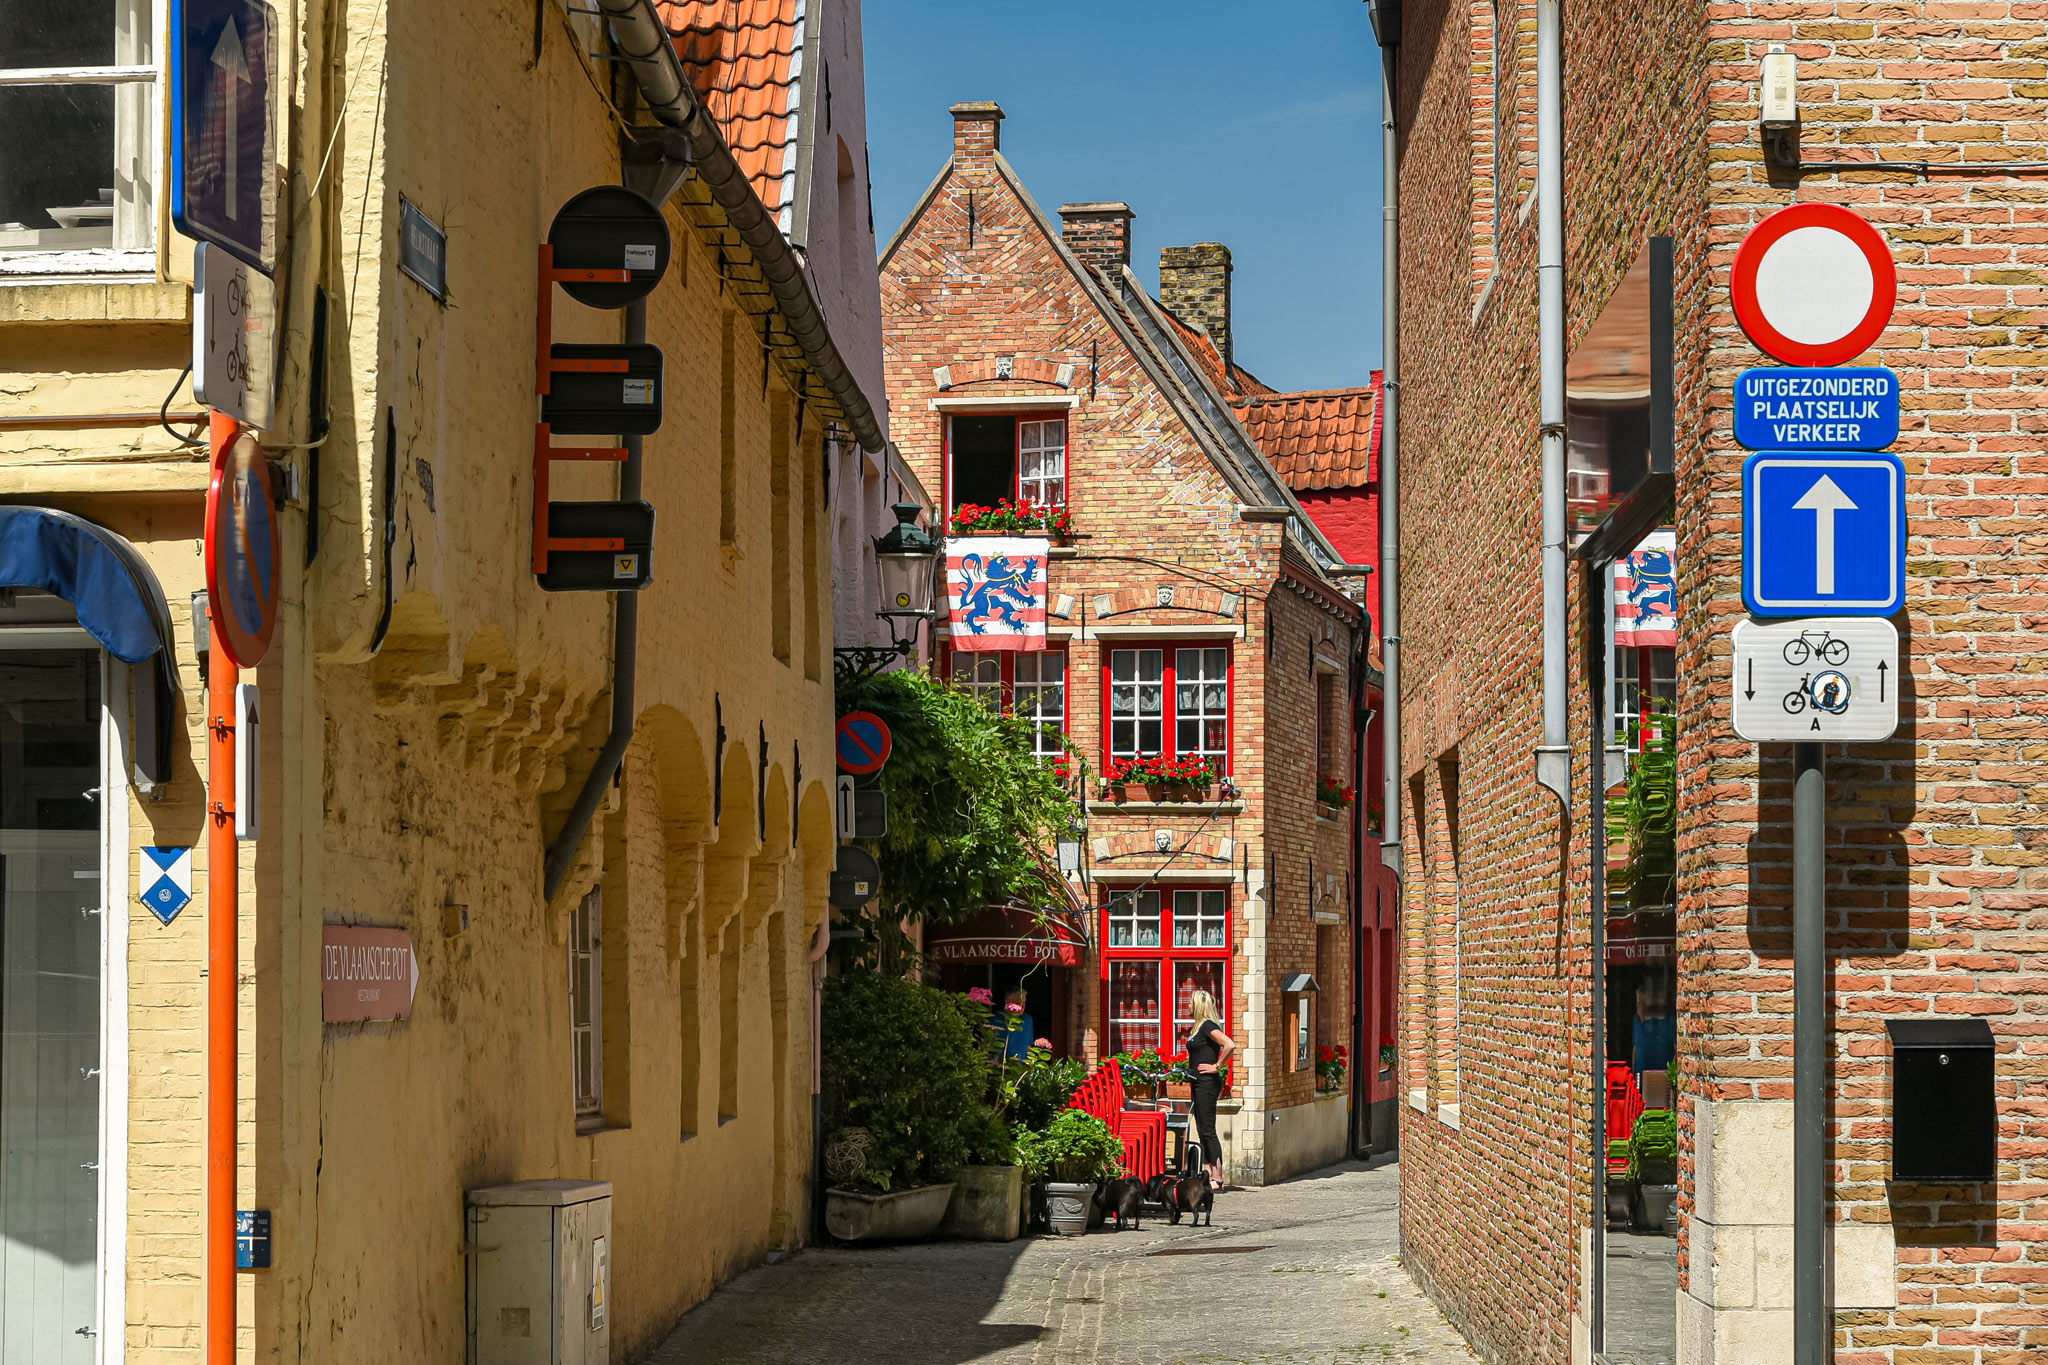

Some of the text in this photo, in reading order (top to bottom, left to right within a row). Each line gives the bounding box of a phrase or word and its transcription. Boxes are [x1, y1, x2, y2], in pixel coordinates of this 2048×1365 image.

[1746, 378, 1888, 397] UITGEZONDERD
[237, 390, 243, 410] A
[1753, 401, 1880, 419] PLAATSELIJK
[1773, 424, 1861, 442] VERKEER
[1810, 717, 1821, 731] A
[943, 944, 1027, 958] VLAAMSCHE
[1034, 947, 1058, 959] POT
[325, 944, 408, 980] DE VLAAMSCHE POT
